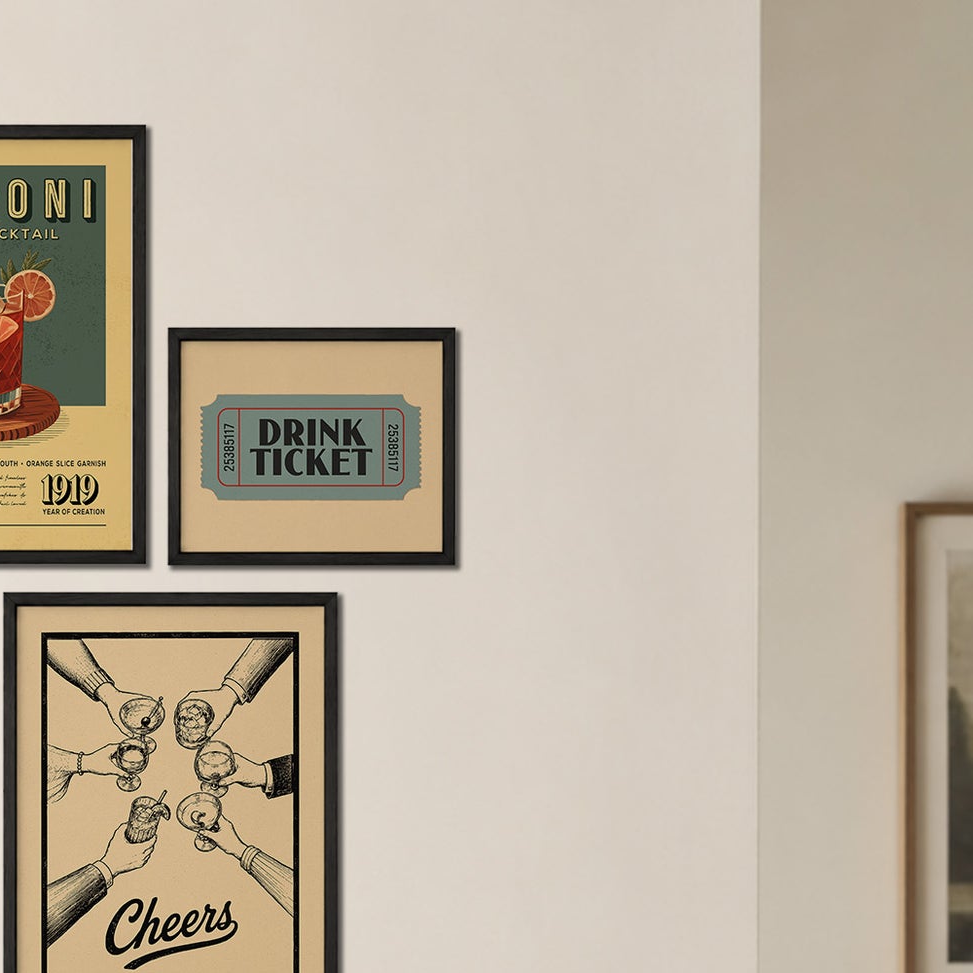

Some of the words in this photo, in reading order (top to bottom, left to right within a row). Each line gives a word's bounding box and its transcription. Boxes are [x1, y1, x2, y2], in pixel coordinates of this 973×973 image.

[223, 423, 235, 472] 25385117
[259, 418, 367, 446] DRINK
[387, 423, 399, 472] 25385117
[250, 448, 373, 476] TICKET
[40, 473, 99, 505] 1919
[105, 896, 239, 970] Cheers
